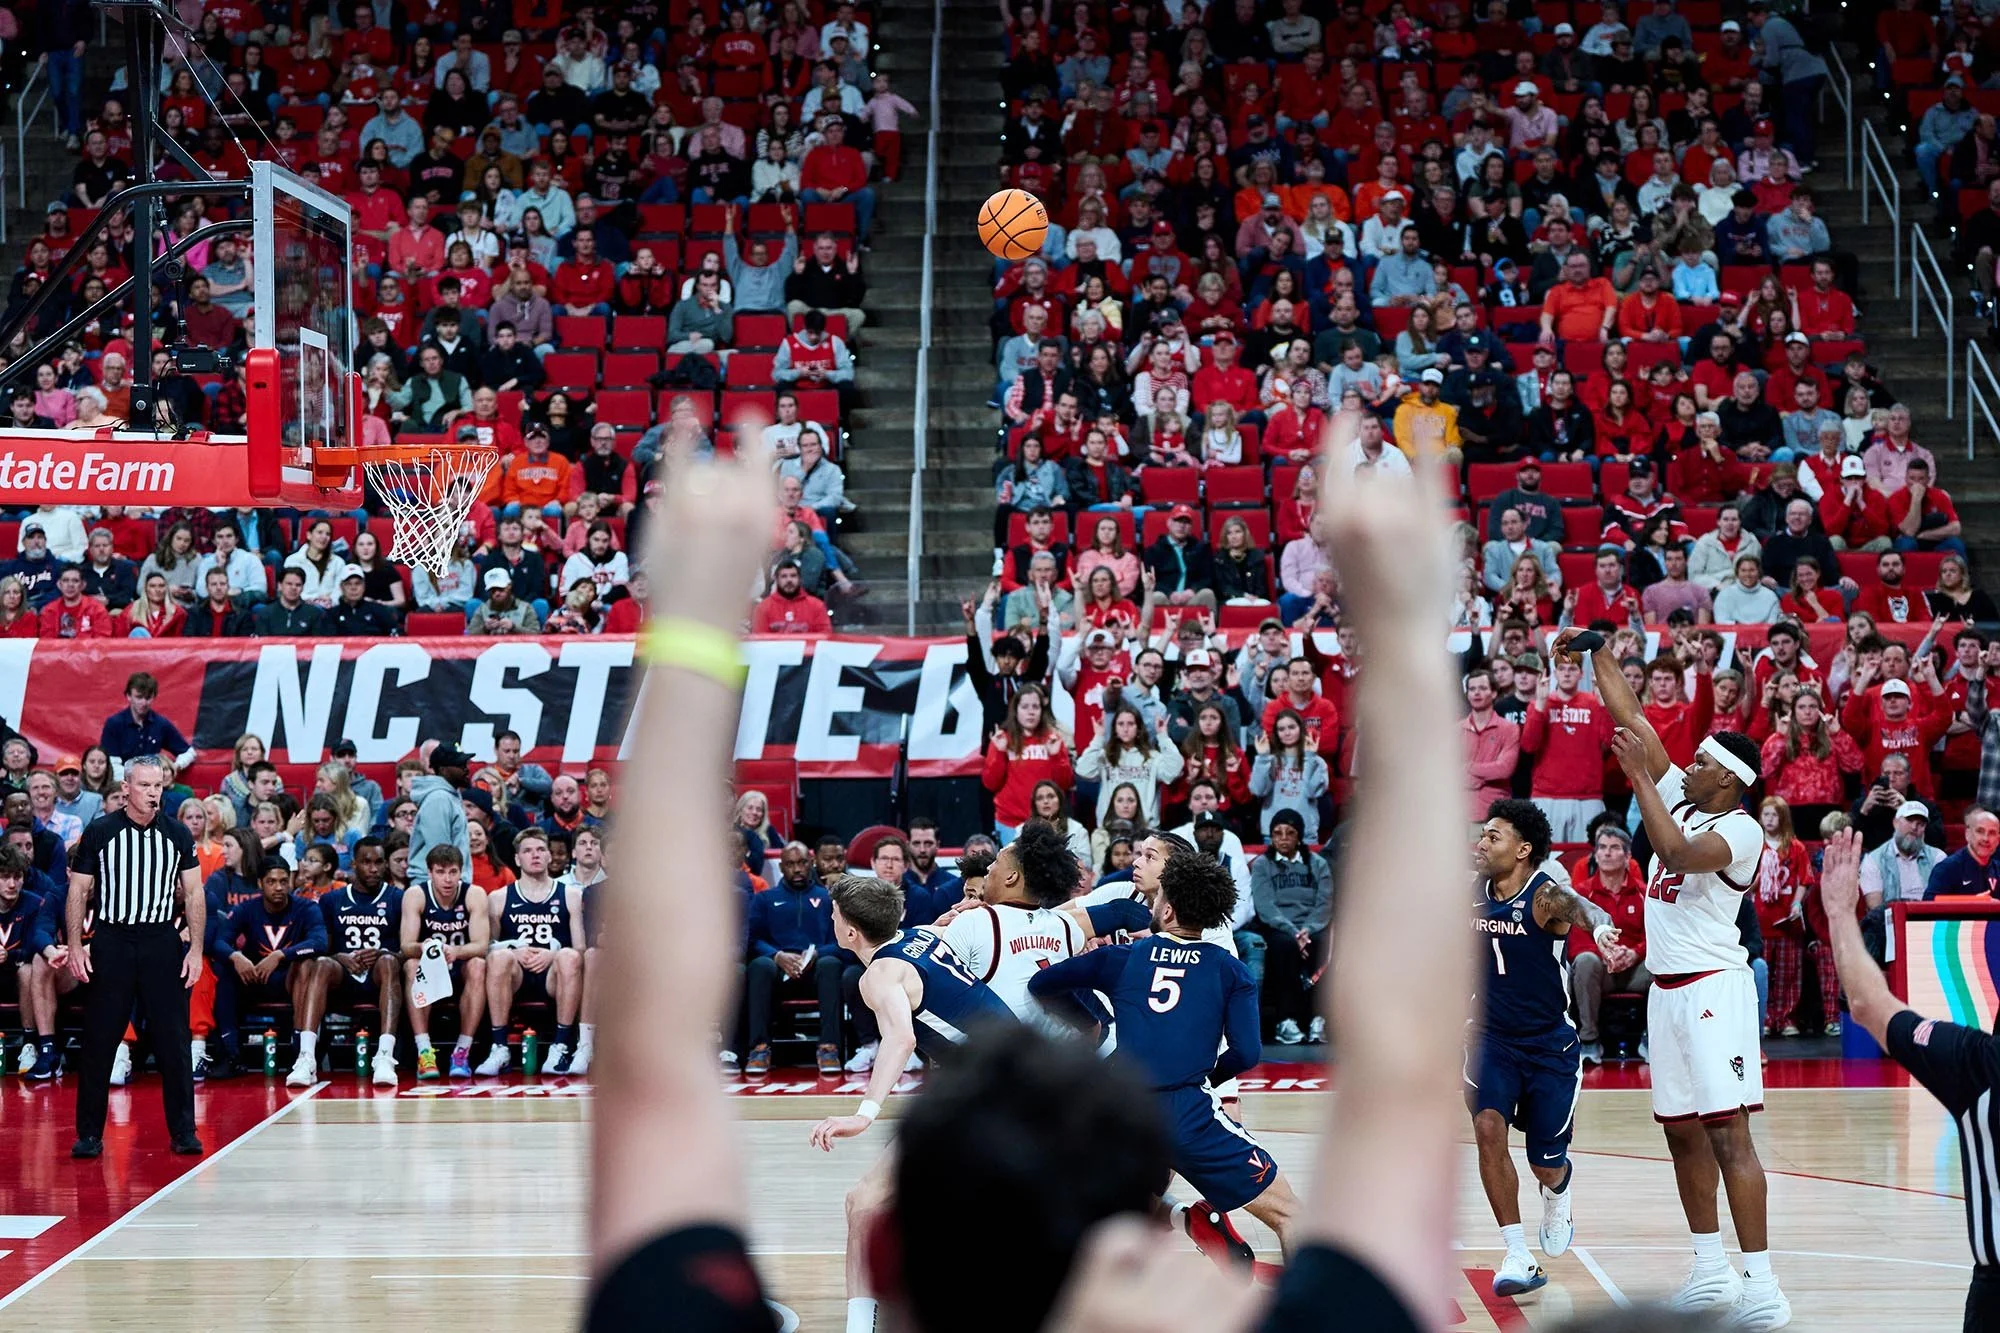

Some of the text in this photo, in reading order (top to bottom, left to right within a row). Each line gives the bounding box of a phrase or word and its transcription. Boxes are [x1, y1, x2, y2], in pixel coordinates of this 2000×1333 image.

[0, 452, 175, 491] tate Farm
[246, 643, 435, 765] NC
[461, 641, 884, 765] STTE
[1562, 706, 1591, 724] STATE
[1648, 863, 1685, 905] 22
[338, 915, 389, 926] VIRGINIA
[425, 919, 470, 932] VIRGINIA
[509, 914, 561, 925] VIRGINIA
[1467, 918, 1527, 937] VIRGINIA
[345, 926, 382, 951] 33
[517, 924, 553, 945] 28
[1009, 935, 1062, 955] WILLIAMS
[1150, 946, 1201, 965] LEWIS
[1147, 966, 1186, 1013] 5
[266, 1043, 276, 1055] G
[357, 1043, 367, 1055] G
